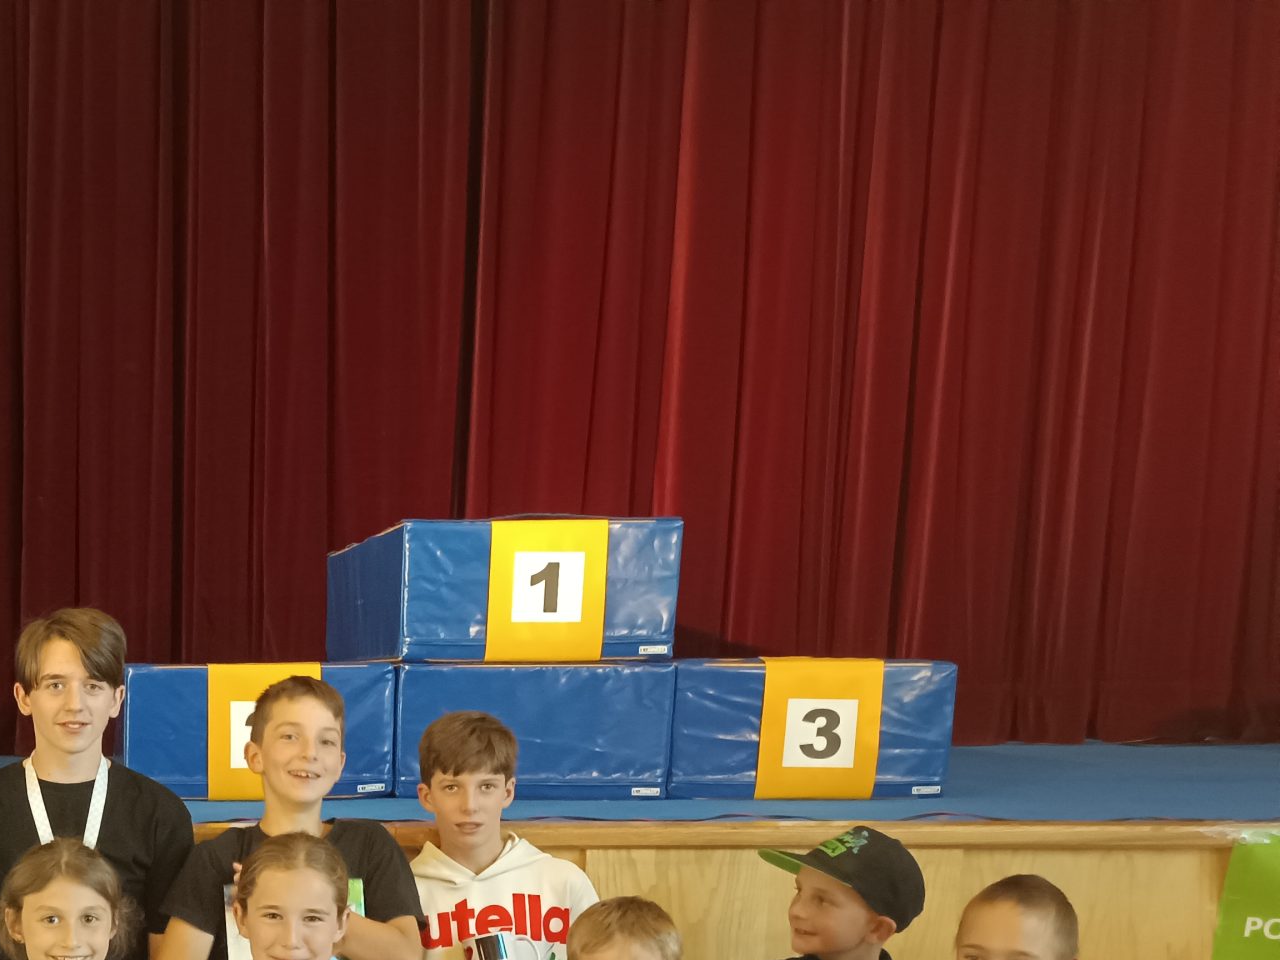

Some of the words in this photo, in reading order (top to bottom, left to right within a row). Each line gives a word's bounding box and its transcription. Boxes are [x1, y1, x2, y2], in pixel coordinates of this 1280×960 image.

[530, 562, 560, 613] 1
[799, 708, 841, 759] 3
[420, 893, 572, 950] utella
